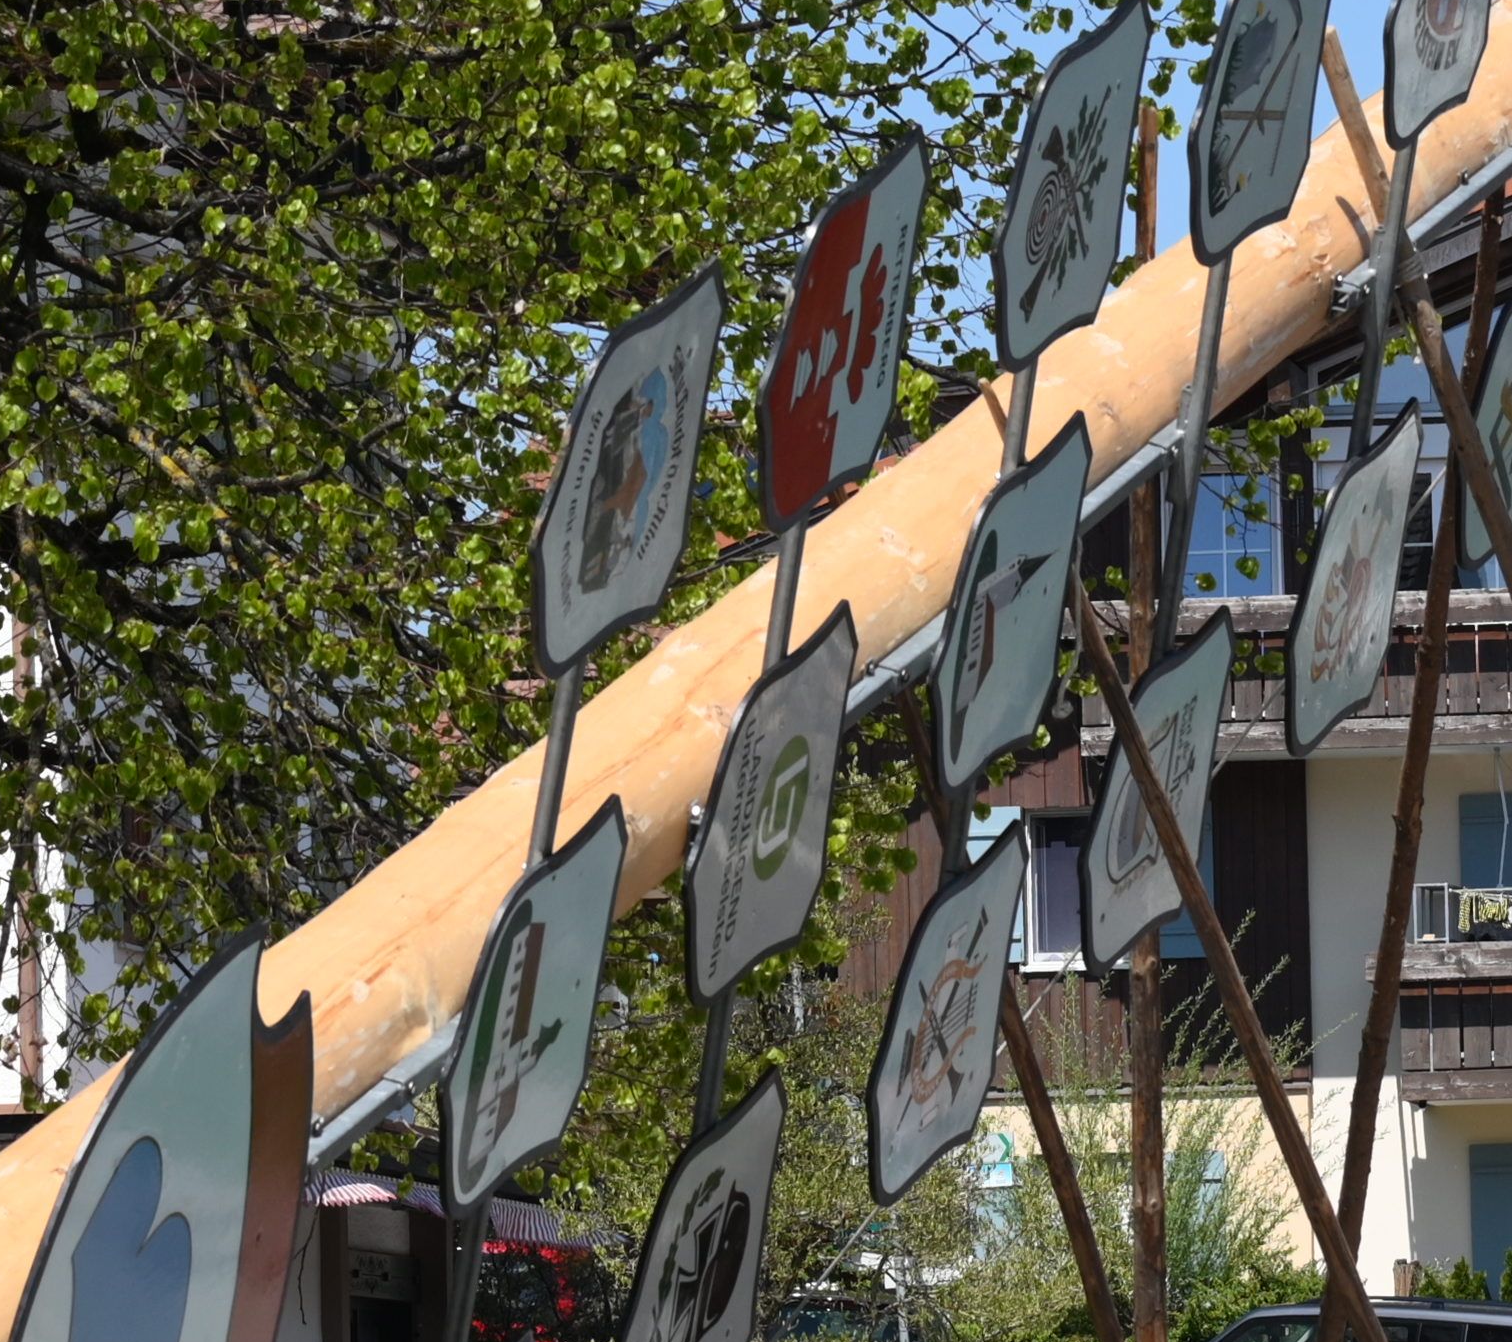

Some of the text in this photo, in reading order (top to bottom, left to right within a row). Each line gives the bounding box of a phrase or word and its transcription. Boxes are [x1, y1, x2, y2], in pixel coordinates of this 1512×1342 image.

[876, 223, 909, 389] RETTENBERG
[706, 718, 757, 979] Untermaiselstein
[725, 734, 766, 943] LANDJUGEND
